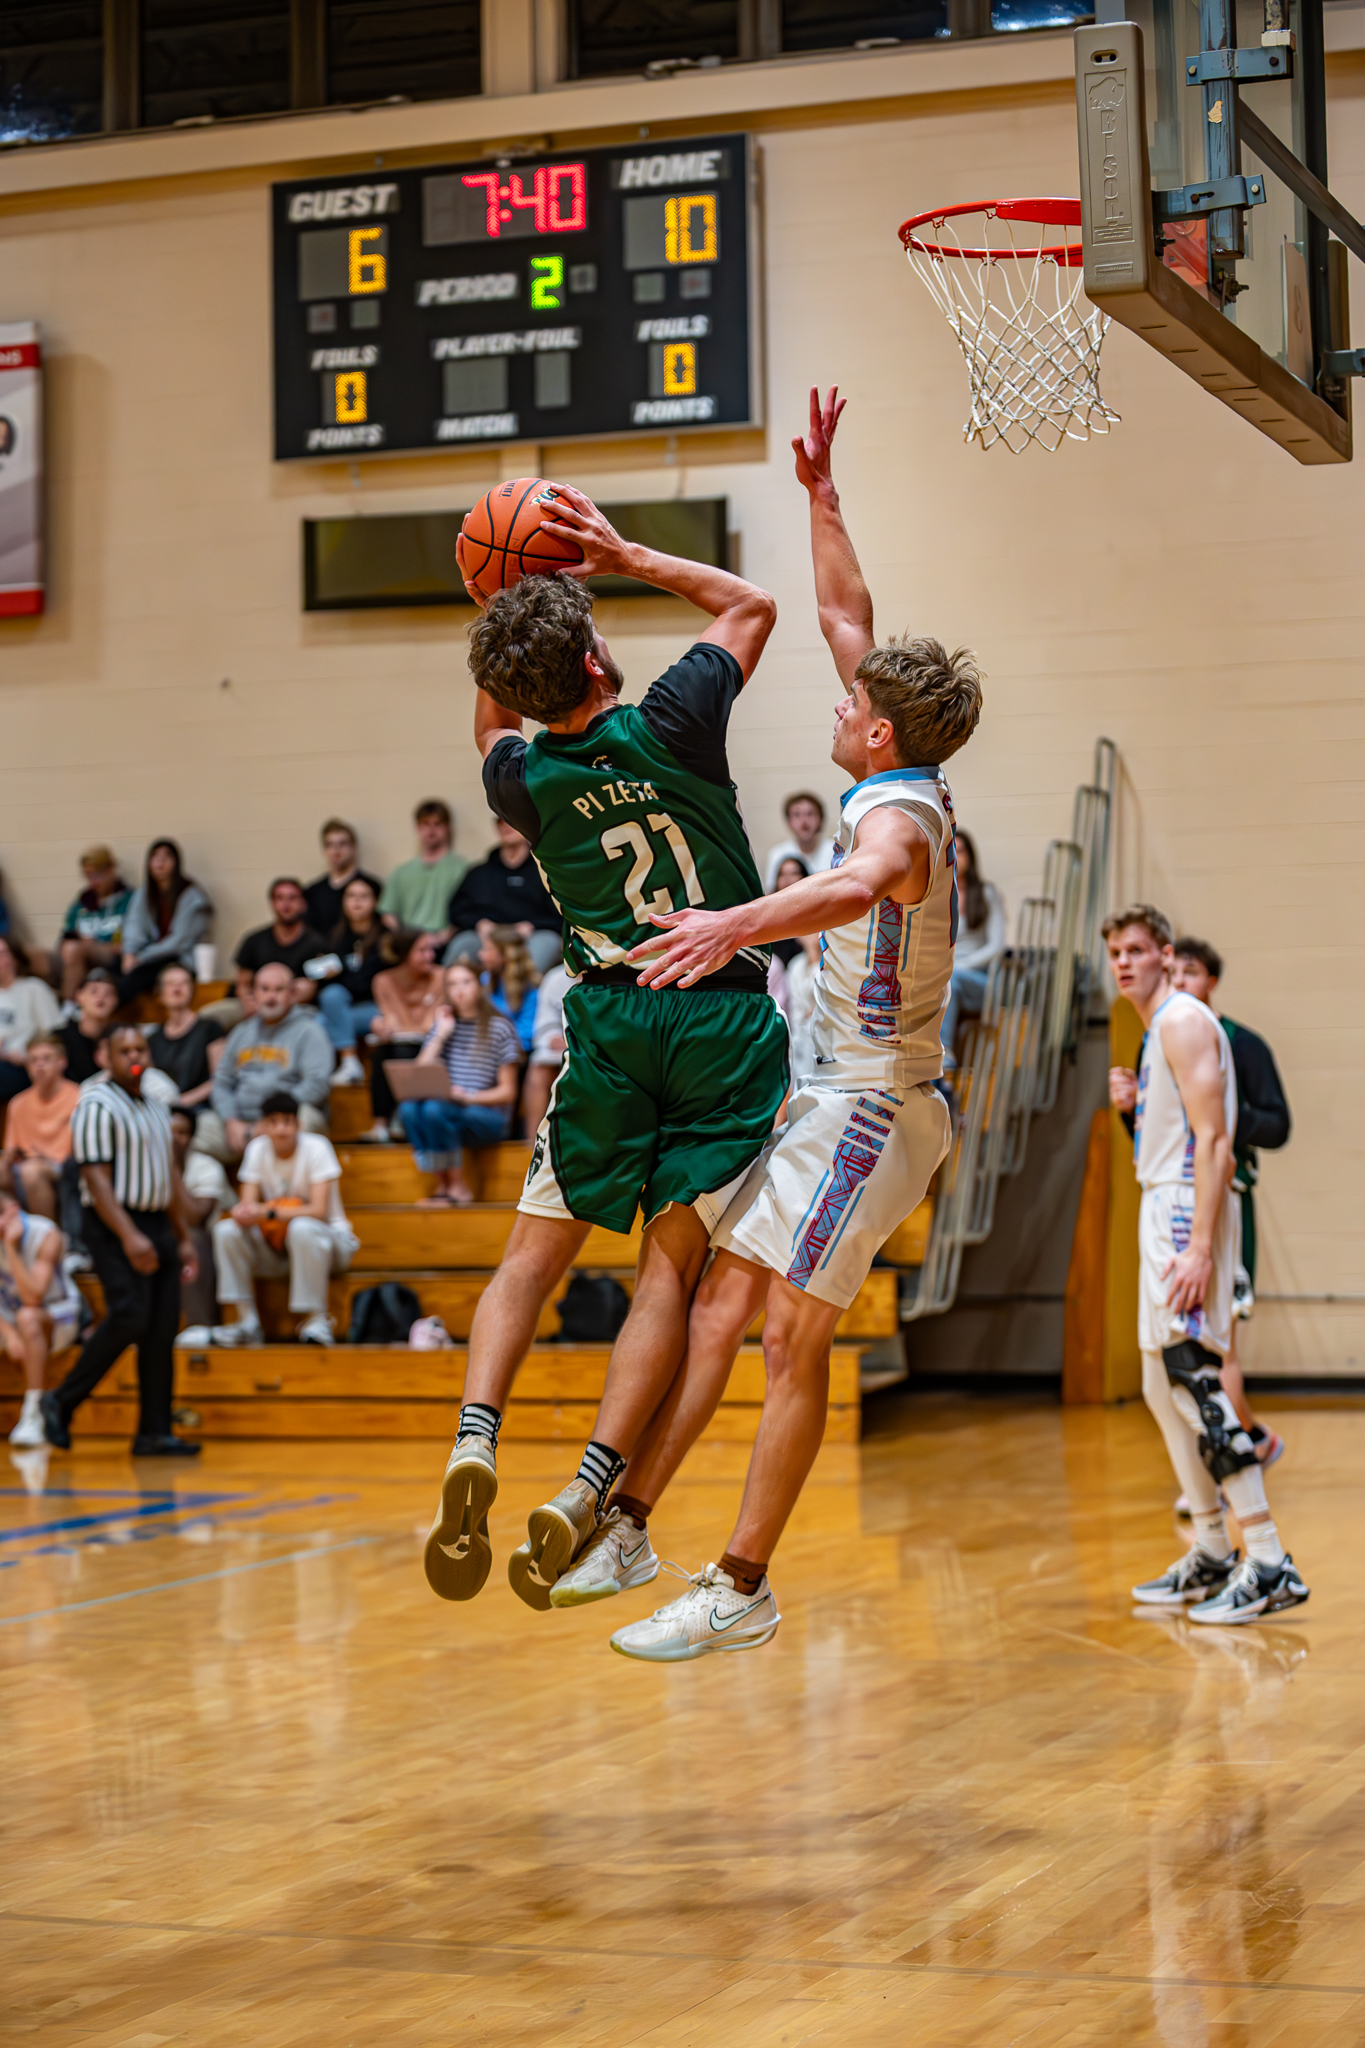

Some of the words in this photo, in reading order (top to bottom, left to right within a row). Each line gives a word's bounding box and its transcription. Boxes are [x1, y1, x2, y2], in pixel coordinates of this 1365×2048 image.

[619, 150, 722, 188] HOME
[288, 183, 398, 222] GUEST
[461, 164, 586, 238] 7:40
[664, 194, 718, 265] 10
[348, 227, 387, 294] 6
[531, 256, 564, 310] 2
[417, 272, 519, 307] PERIOD
[433, 326, 581, 360] PLAYER-FOUL
[638, 314, 710, 342] FOULS
[311, 344, 379, 371] FOULS
[663, 342, 696, 396] 0
[335, 371, 368, 424] 0
[572, 791, 605, 820] PI
[601, 780, 660, 807] ZETA
[600, 811, 706, 927] 21
